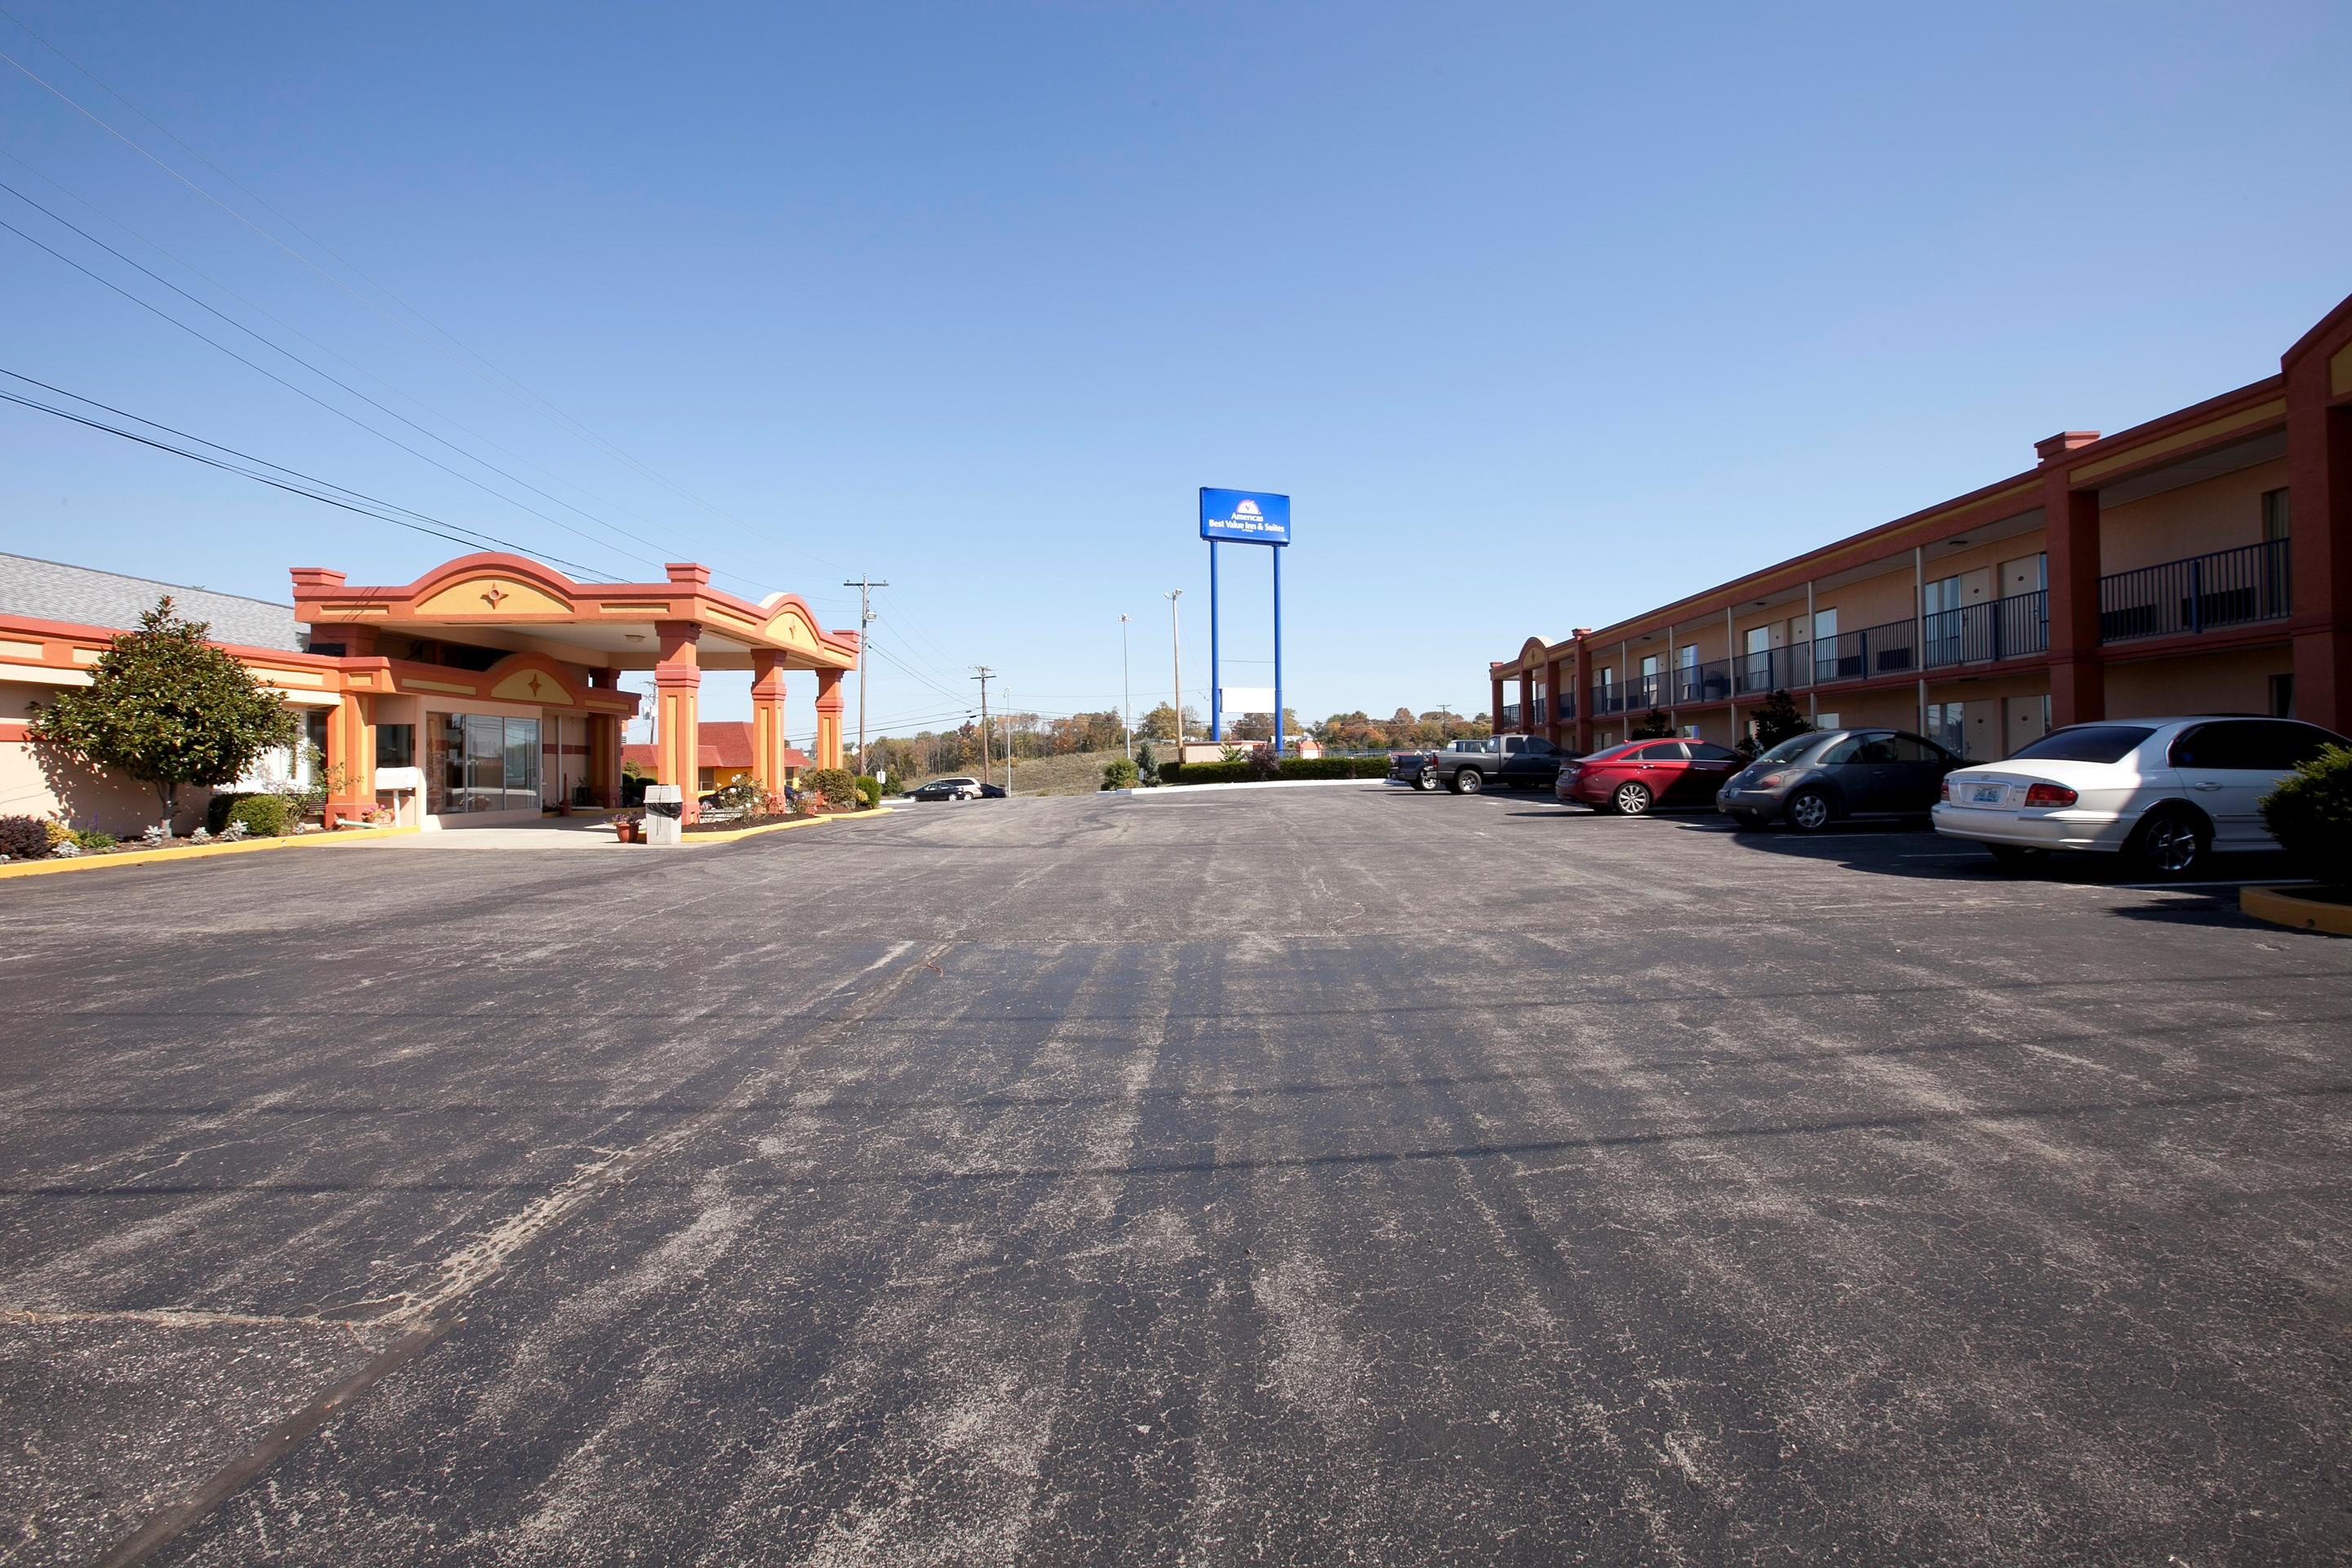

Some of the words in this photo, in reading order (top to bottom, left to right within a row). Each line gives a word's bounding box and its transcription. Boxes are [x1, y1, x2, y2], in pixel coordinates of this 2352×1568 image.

[1209, 519, 1224, 528] Best
[1225, 520, 1244, 529] Value
[1245, 522, 1256, 530] Inn
[1258, 523, 1263, 531] &
[1265, 523, 1285, 532] Suites
